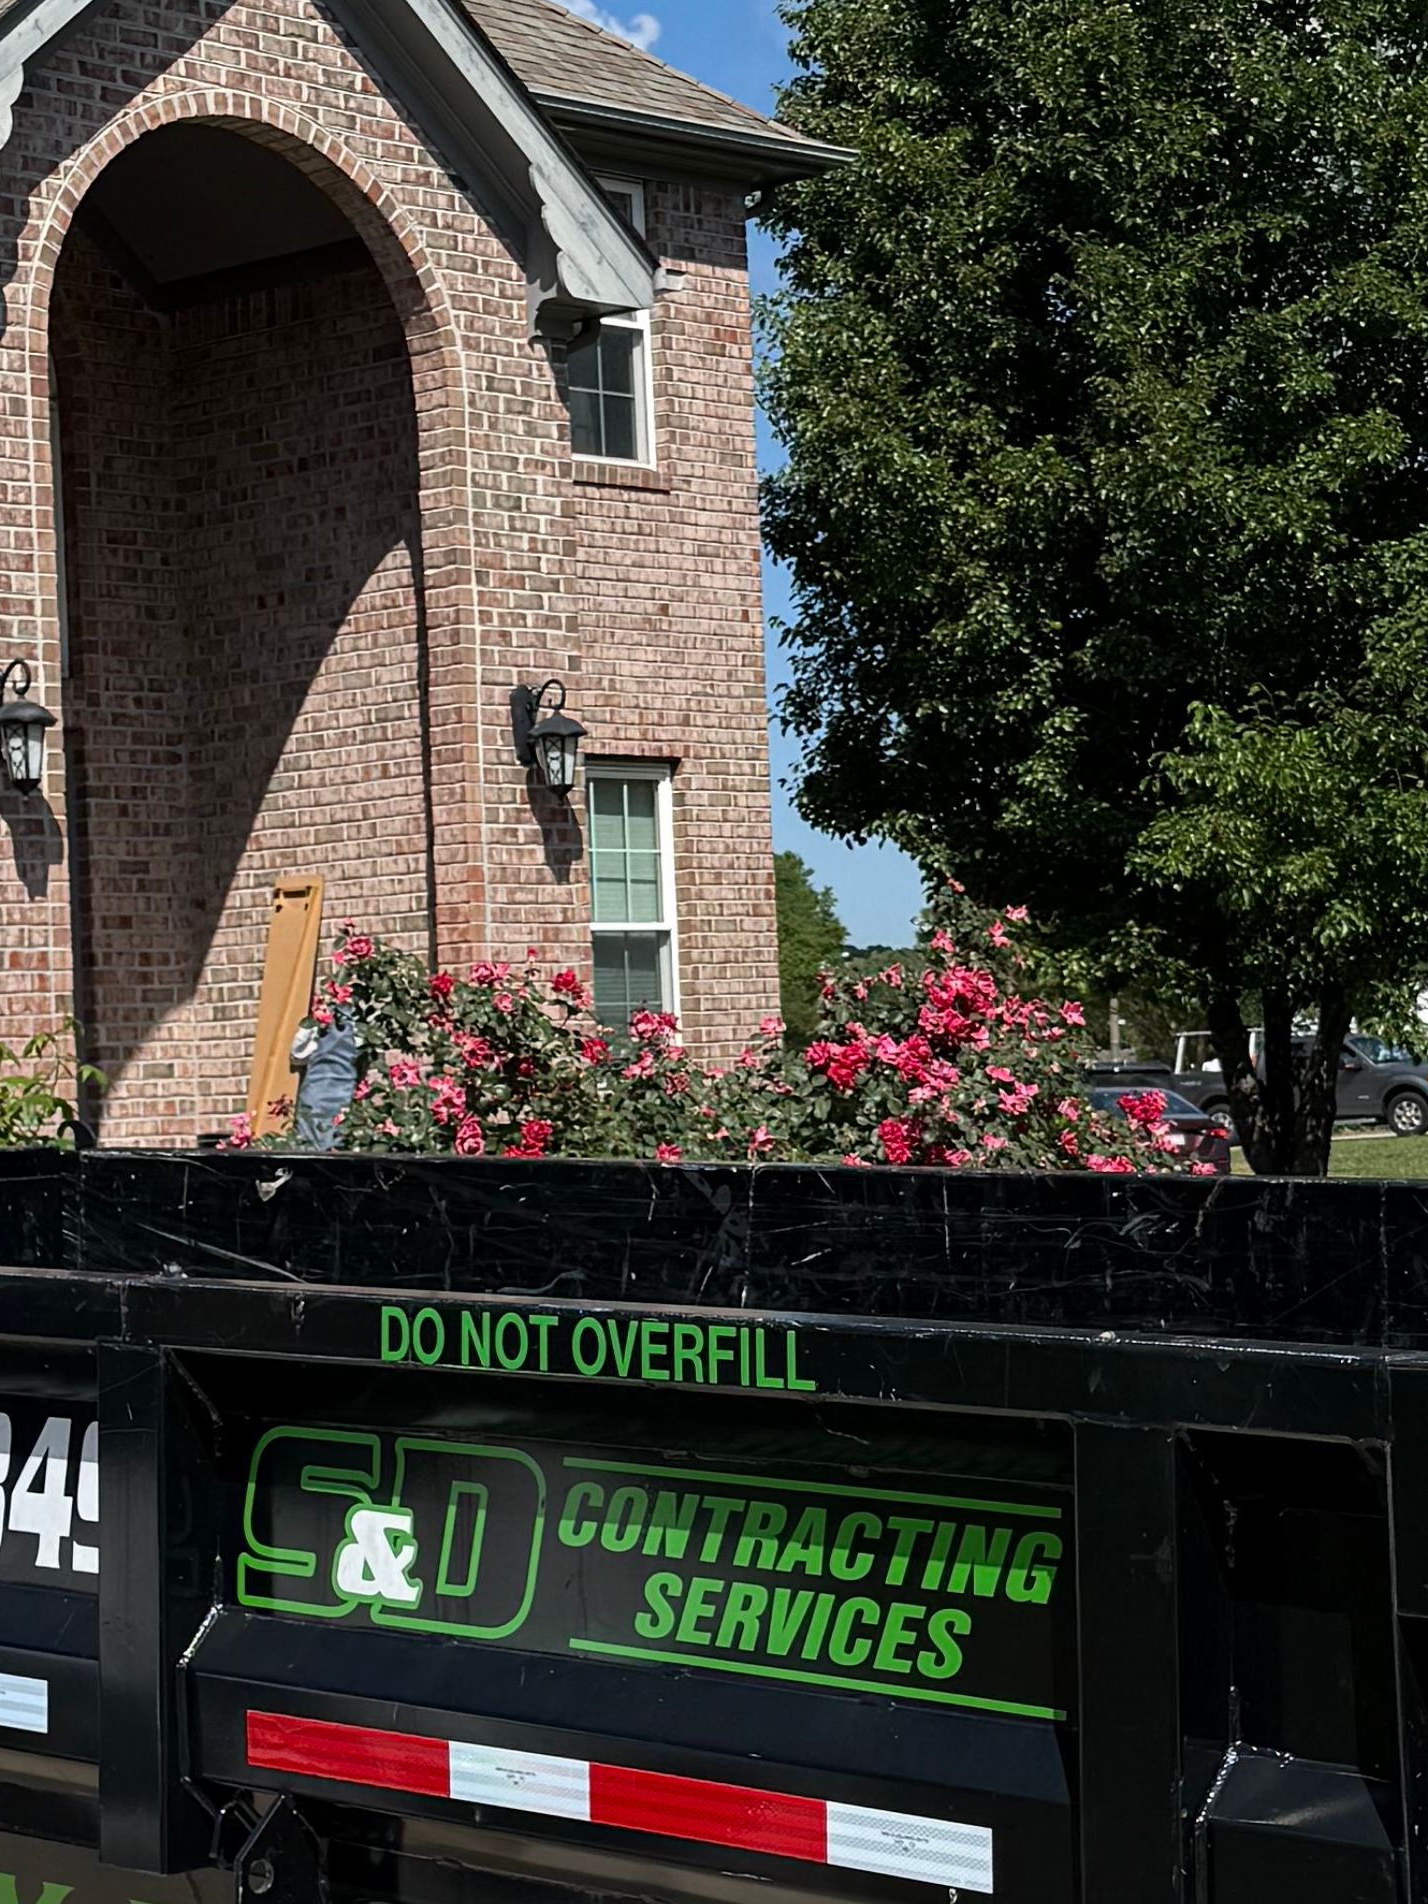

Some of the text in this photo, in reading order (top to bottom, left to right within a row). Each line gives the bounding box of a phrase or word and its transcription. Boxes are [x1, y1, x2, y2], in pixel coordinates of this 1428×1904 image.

[381, 1306, 817, 1392] DO NOT OVERFILL
[236, 1425, 545, 1640] S&D
[557, 1481, 1063, 1605] CONTRACTING
[634, 1571, 973, 1680] SERVICES
